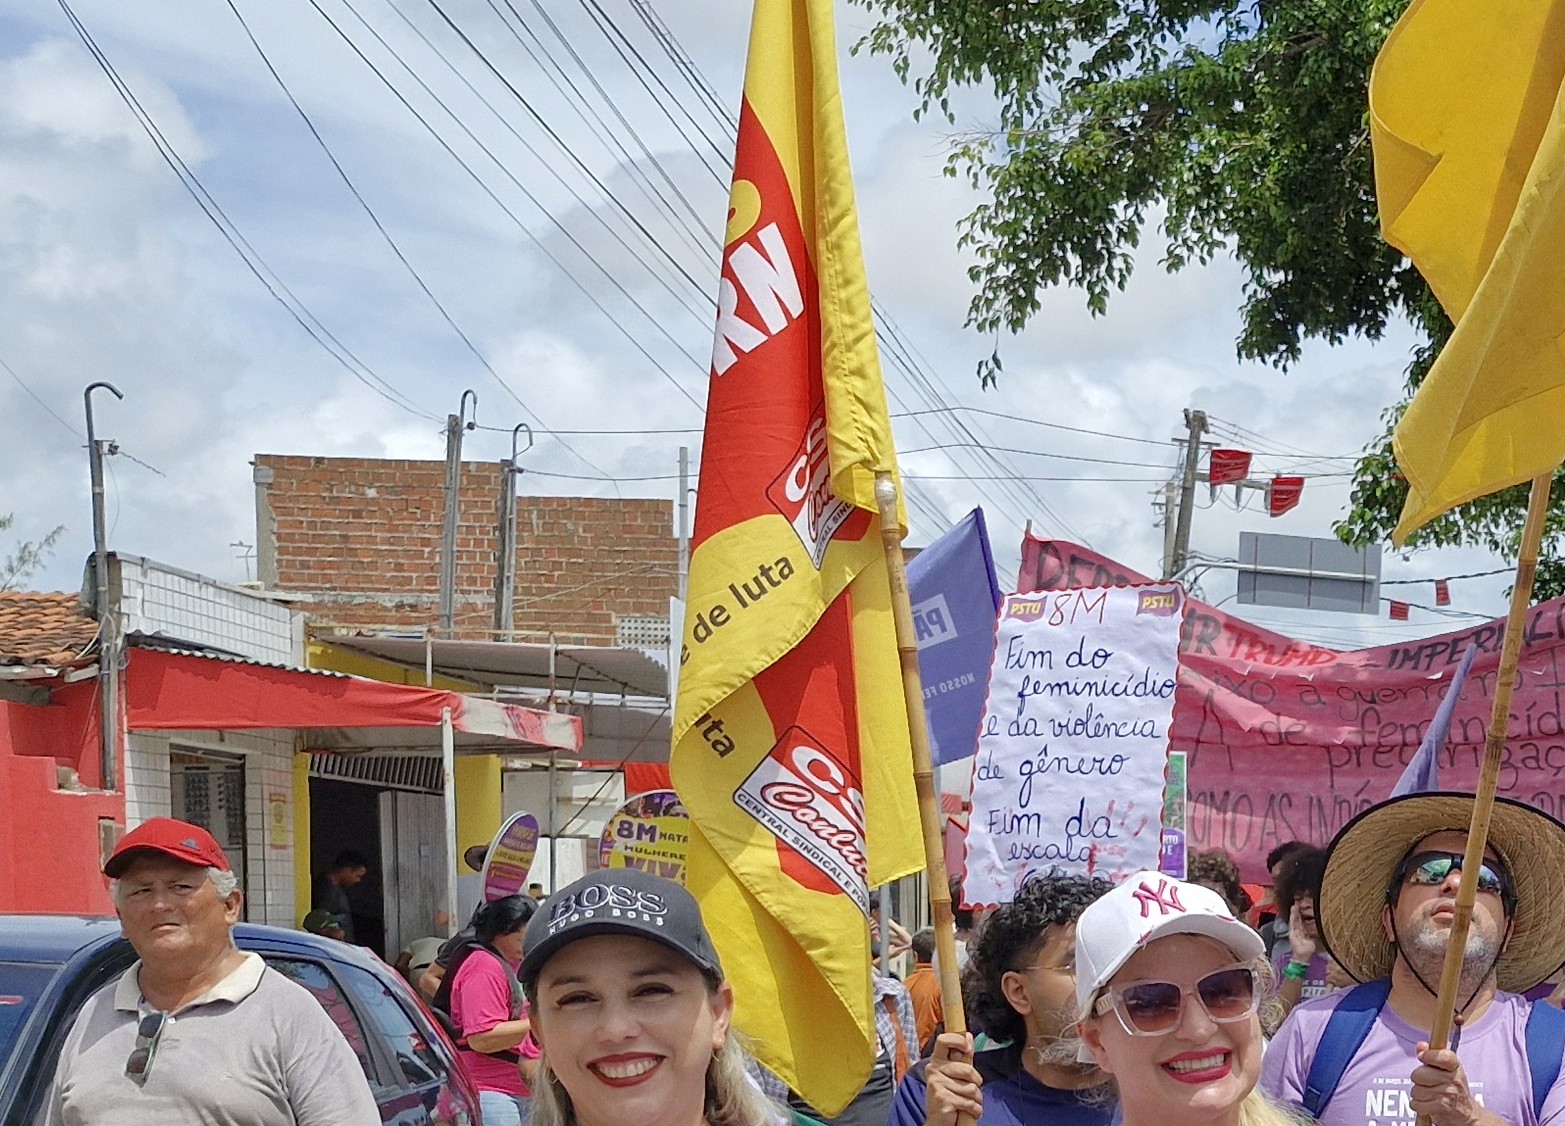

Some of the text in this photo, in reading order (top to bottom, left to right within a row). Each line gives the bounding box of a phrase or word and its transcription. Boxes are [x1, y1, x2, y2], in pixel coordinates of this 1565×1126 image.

[692, 556, 795, 644] de luta
[1010, 601, 1042, 616] PSTU
[1048, 590, 1108, 627] 8M
[1142, 592, 1175, 610] PSTU
[1005, 634, 1115, 670] Fim do
[1018, 665, 1179, 718] feminicídio
[981, 702, 1162, 739] e da violência
[1259, 711, 1310, 747] de
[977, 743, 1132, 809] de gênero
[616, 819, 690, 844] 8M NATA
[987, 796, 1118, 839] Fim da
[1186, 788, 1255, 852] OMO
[624, 844, 688, 861] MULHERE
[736, 793, 790, 839] CENTRAL
[791, 834, 843, 882] SINDICAL
[1007, 836, 1098, 864] escala
[548, 883, 668, 928] BOSS
[1132, 878, 1187, 918] NY
[549, 909, 664, 936] HUGO BOSS
